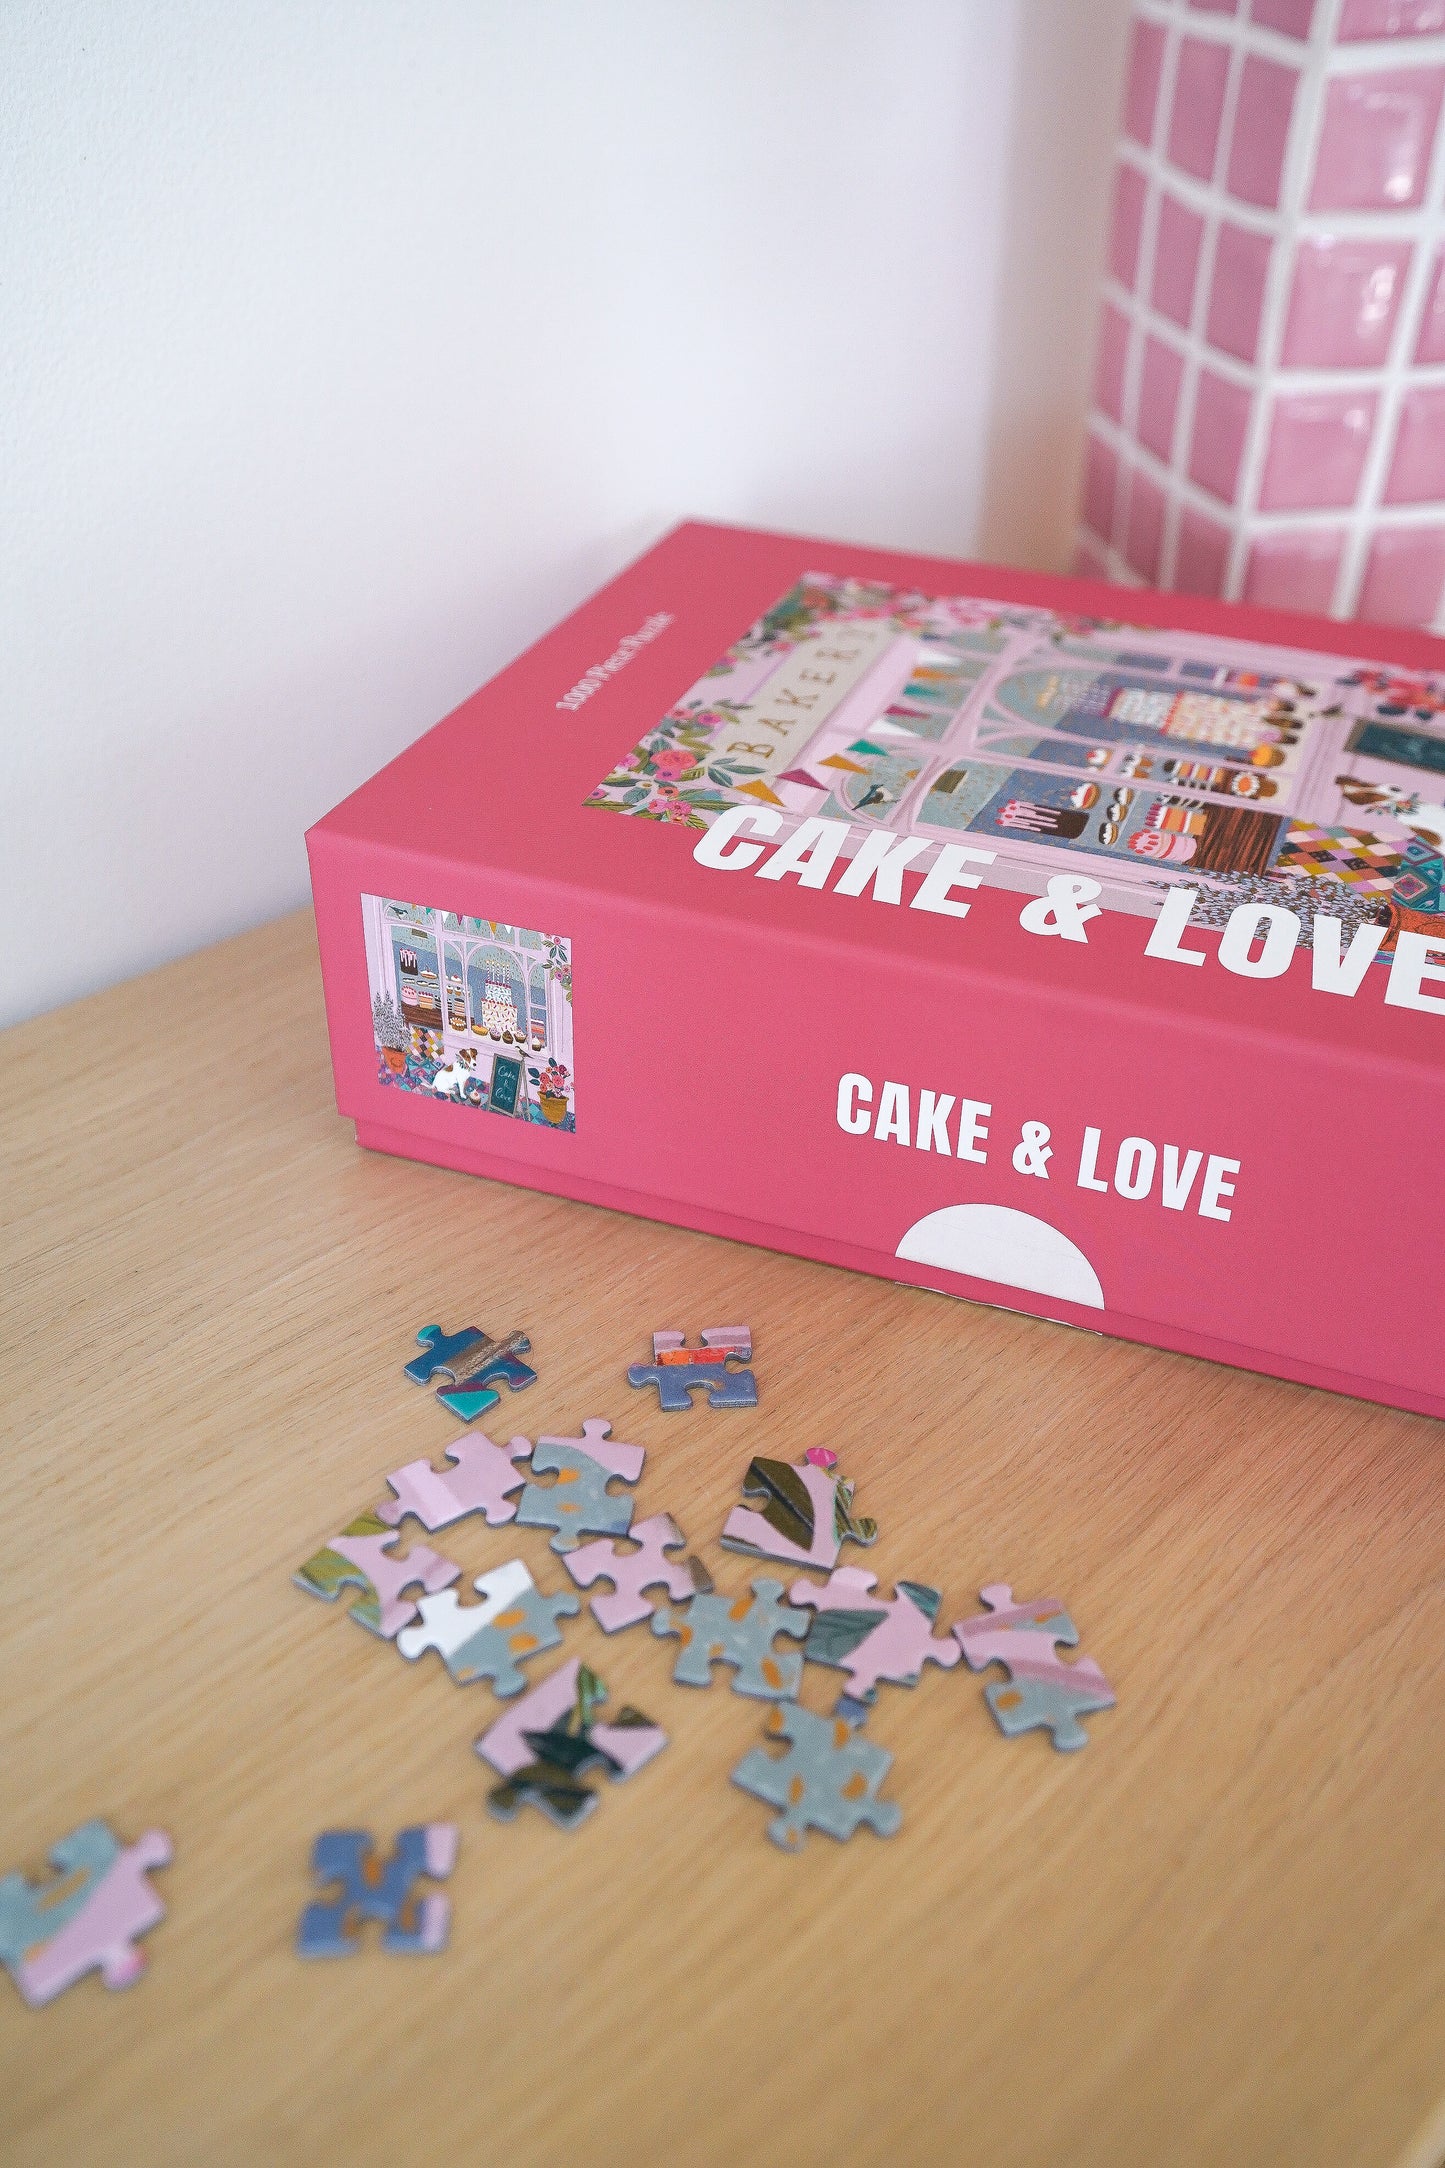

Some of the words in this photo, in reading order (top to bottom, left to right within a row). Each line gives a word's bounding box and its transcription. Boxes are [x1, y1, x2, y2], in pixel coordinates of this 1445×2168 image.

[555, 678, 602, 711] 1000
[692, 804, 999, 919] CAKE
[1019, 874, 1103, 944] &
[1143, 886, 1445, 1016] LOVE
[836, 1072, 992, 1164] CAKE
[1012, 1120, 1054, 1179] &
[1077, 1126, 1241, 1222] LOVE
